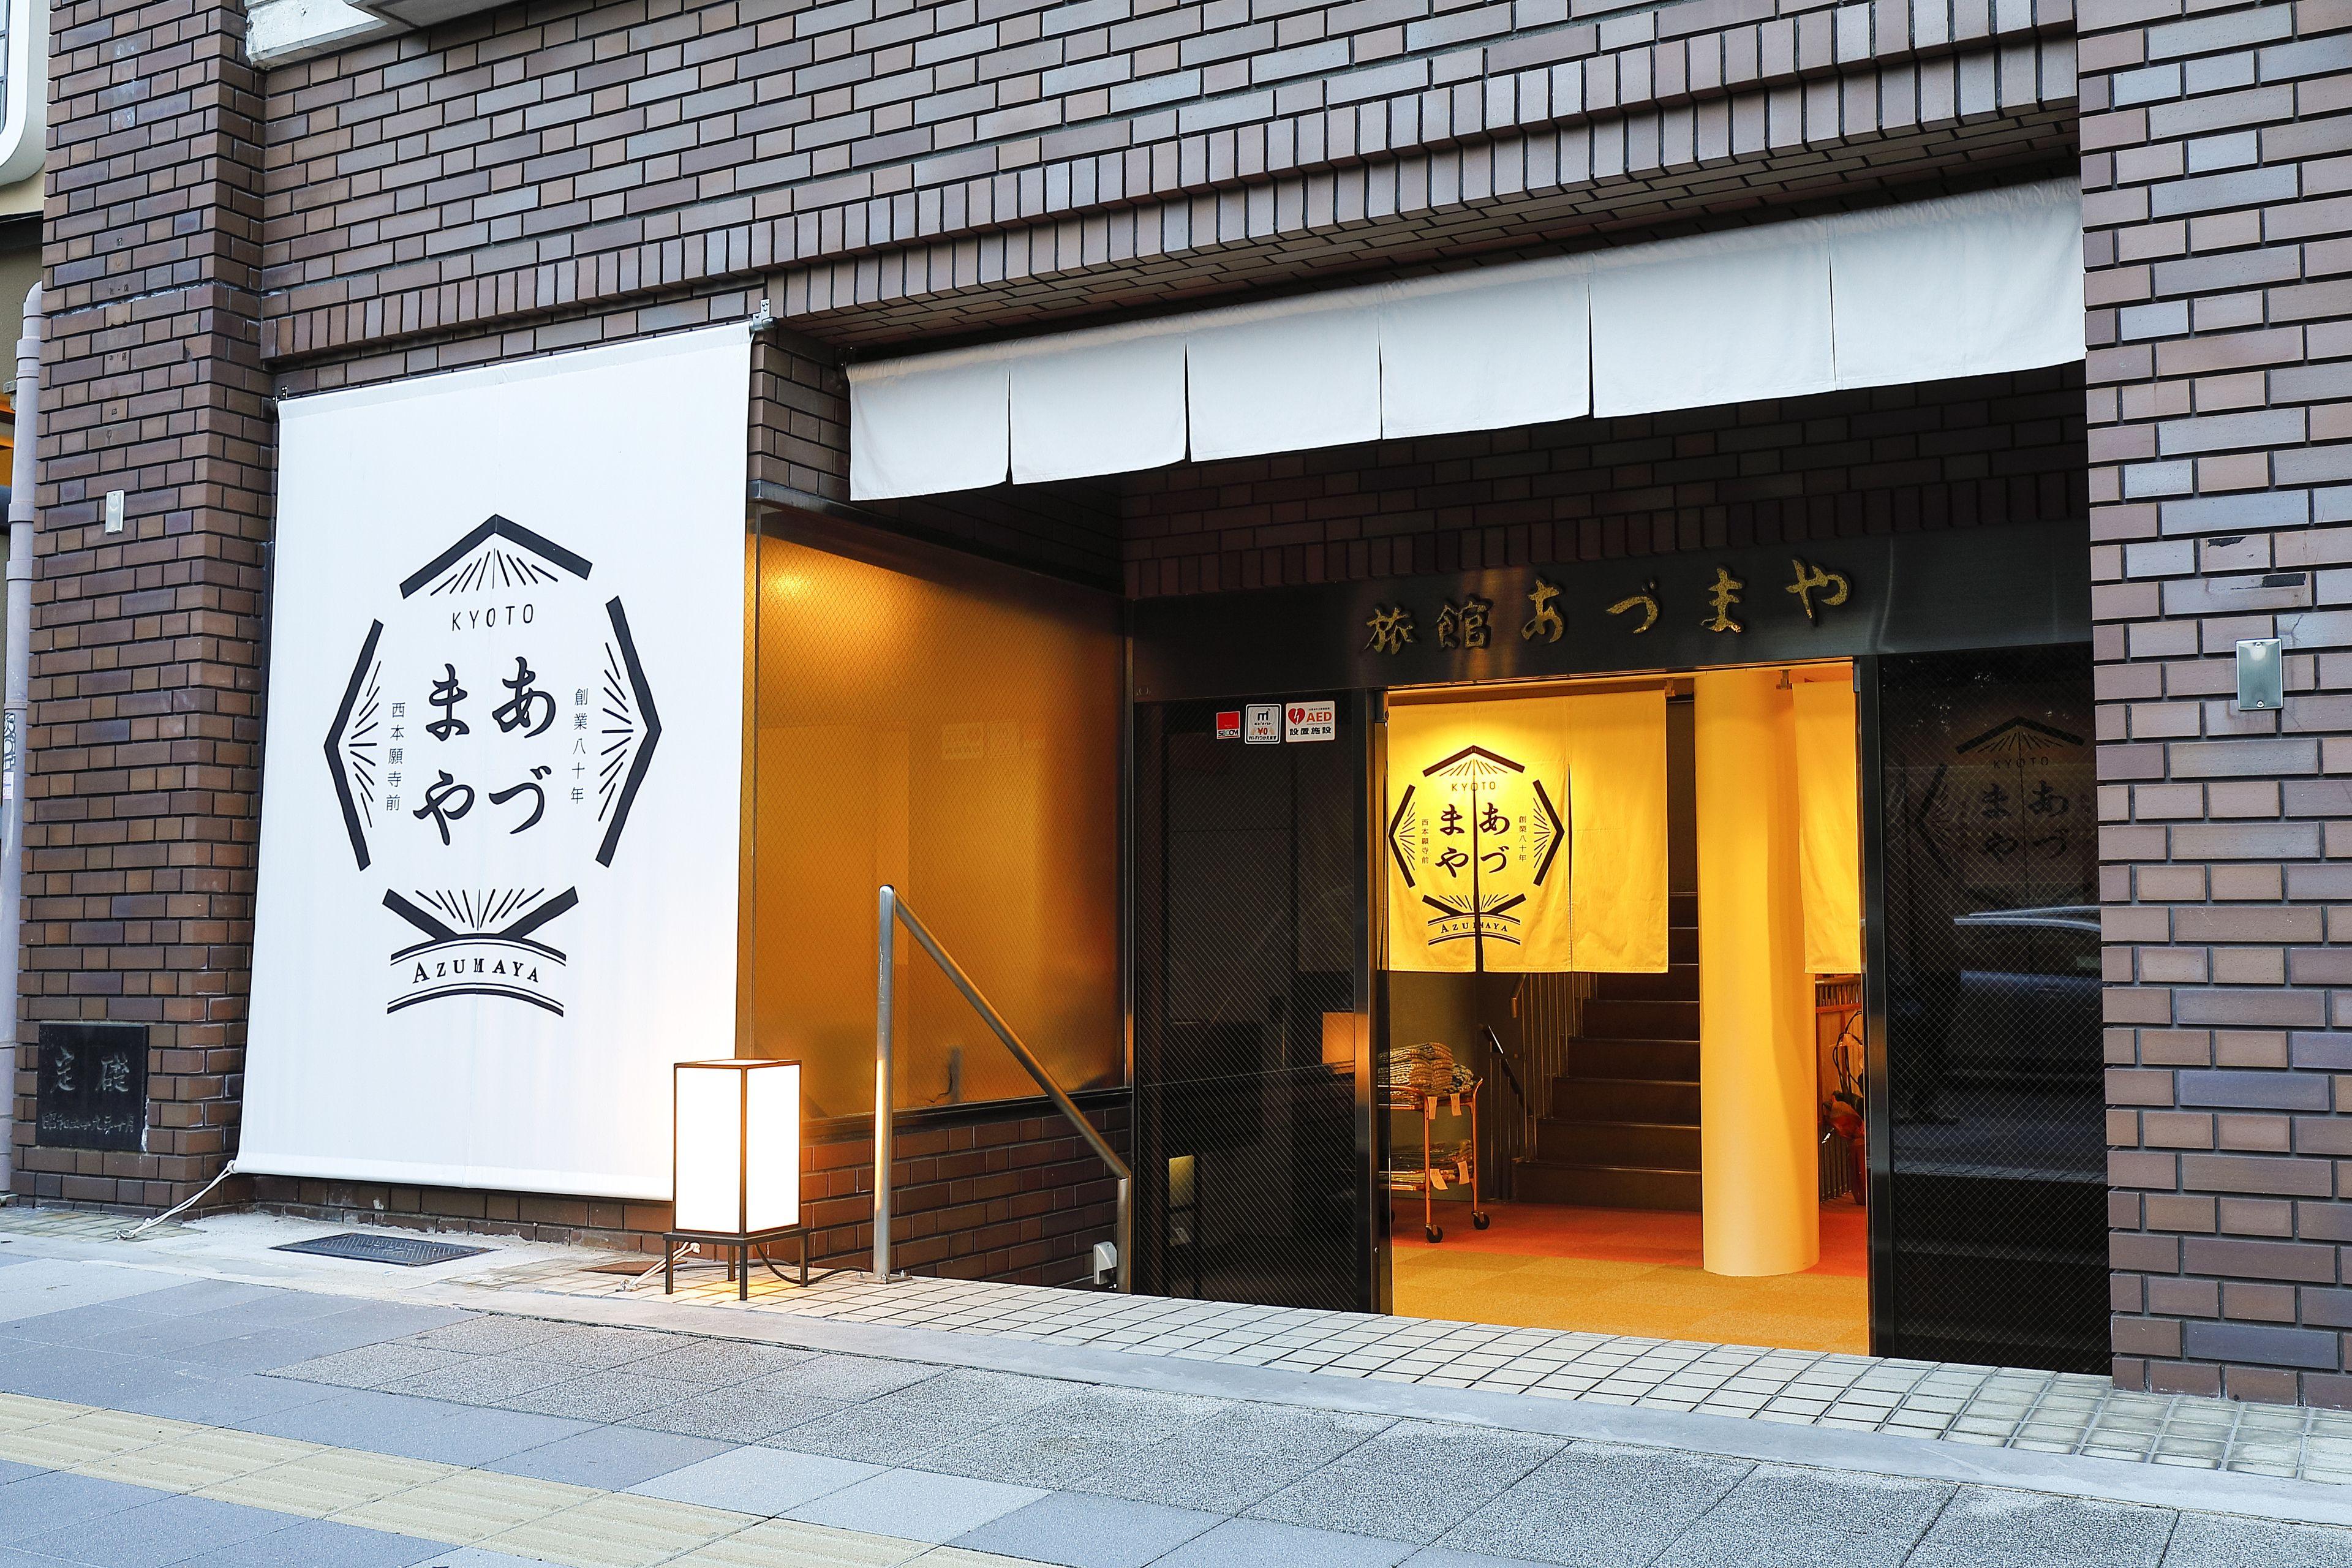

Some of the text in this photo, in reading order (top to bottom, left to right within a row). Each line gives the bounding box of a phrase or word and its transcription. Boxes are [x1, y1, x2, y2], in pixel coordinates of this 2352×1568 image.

[452, 603, 533, 631] KYOTO
[1363, 558, 1849, 655] 旅館あづまや
[1306, 712, 1332, 722] AED
[1289, 726, 1332, 736] 設置施設
[385, 702, 406, 812] 西本願寺前
[570, 688, 589, 805] 創業八十年
[1993, 756, 2049, 769] KYOTO
[1452, 781, 1496, 792] KYOTO
[1518, 816, 1527, 862] 創業八十年
[1441, 921, 1508, 933] AZUMAYA
[412, 957, 539, 983] AZUMAYA
